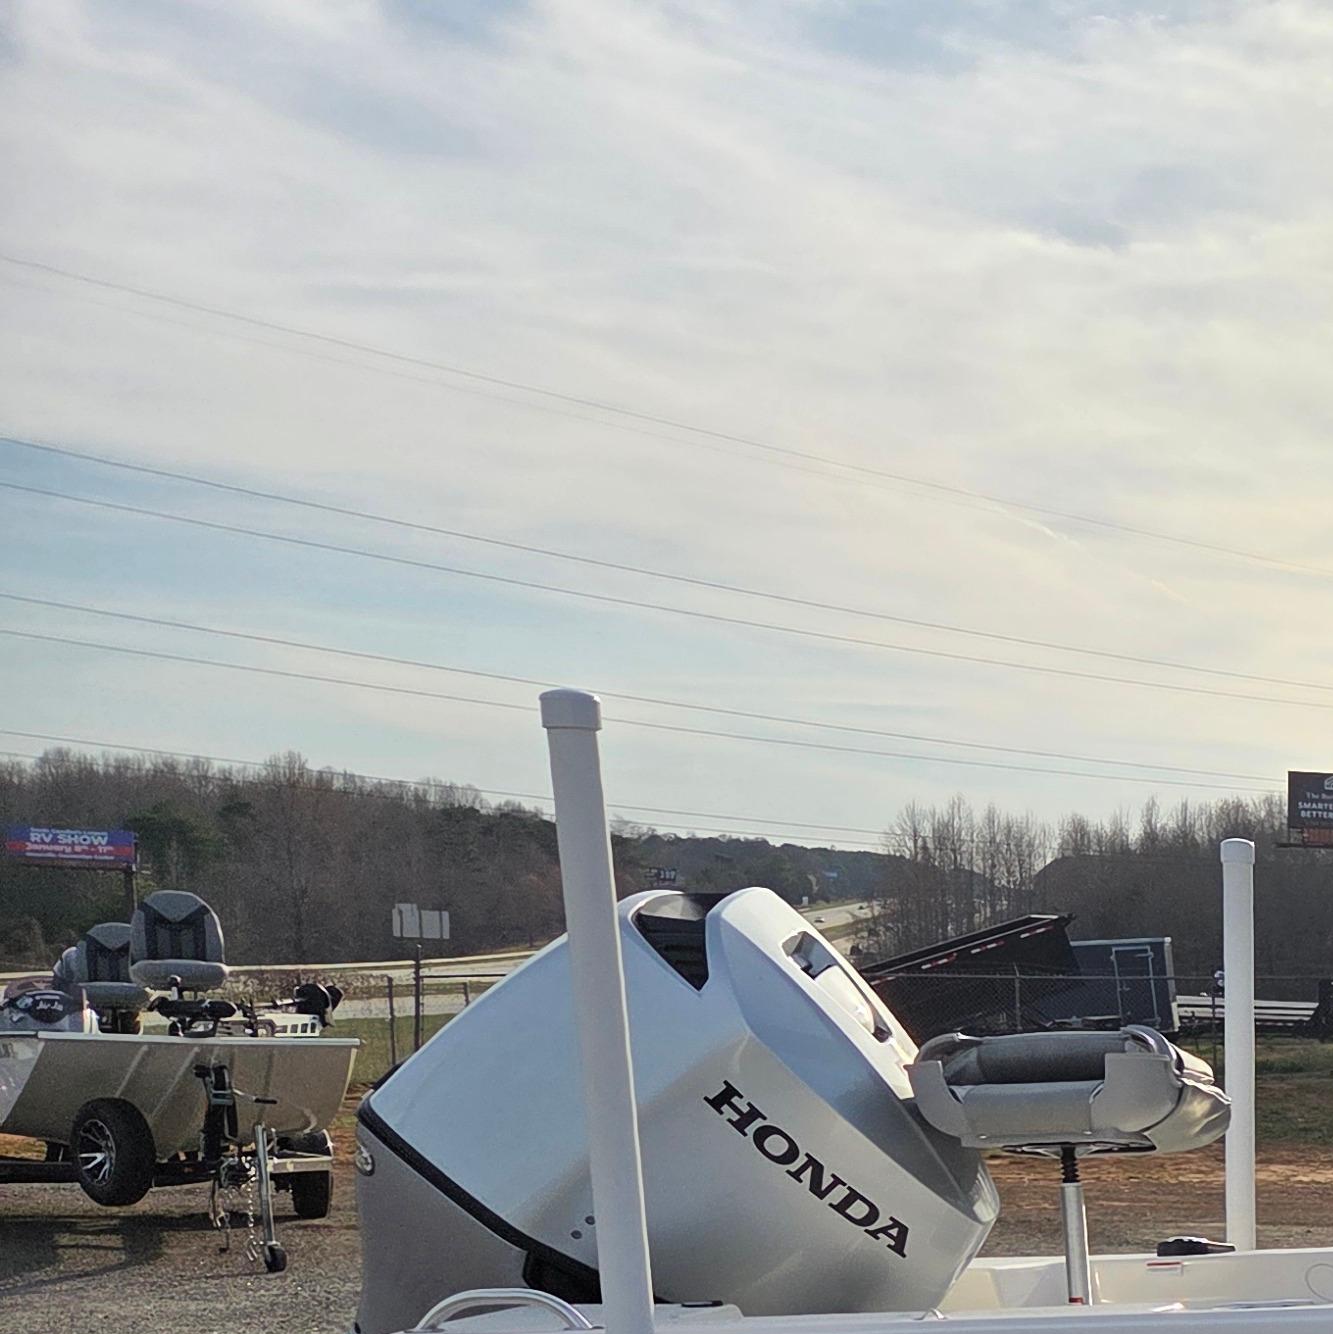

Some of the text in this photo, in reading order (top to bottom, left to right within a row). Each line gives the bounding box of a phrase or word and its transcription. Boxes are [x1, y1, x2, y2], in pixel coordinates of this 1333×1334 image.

[1300, 810, 1333, 819] BETTER
[30, 832, 108, 845] RV SHOW
[703, 1080, 909, 1259] HONDA
